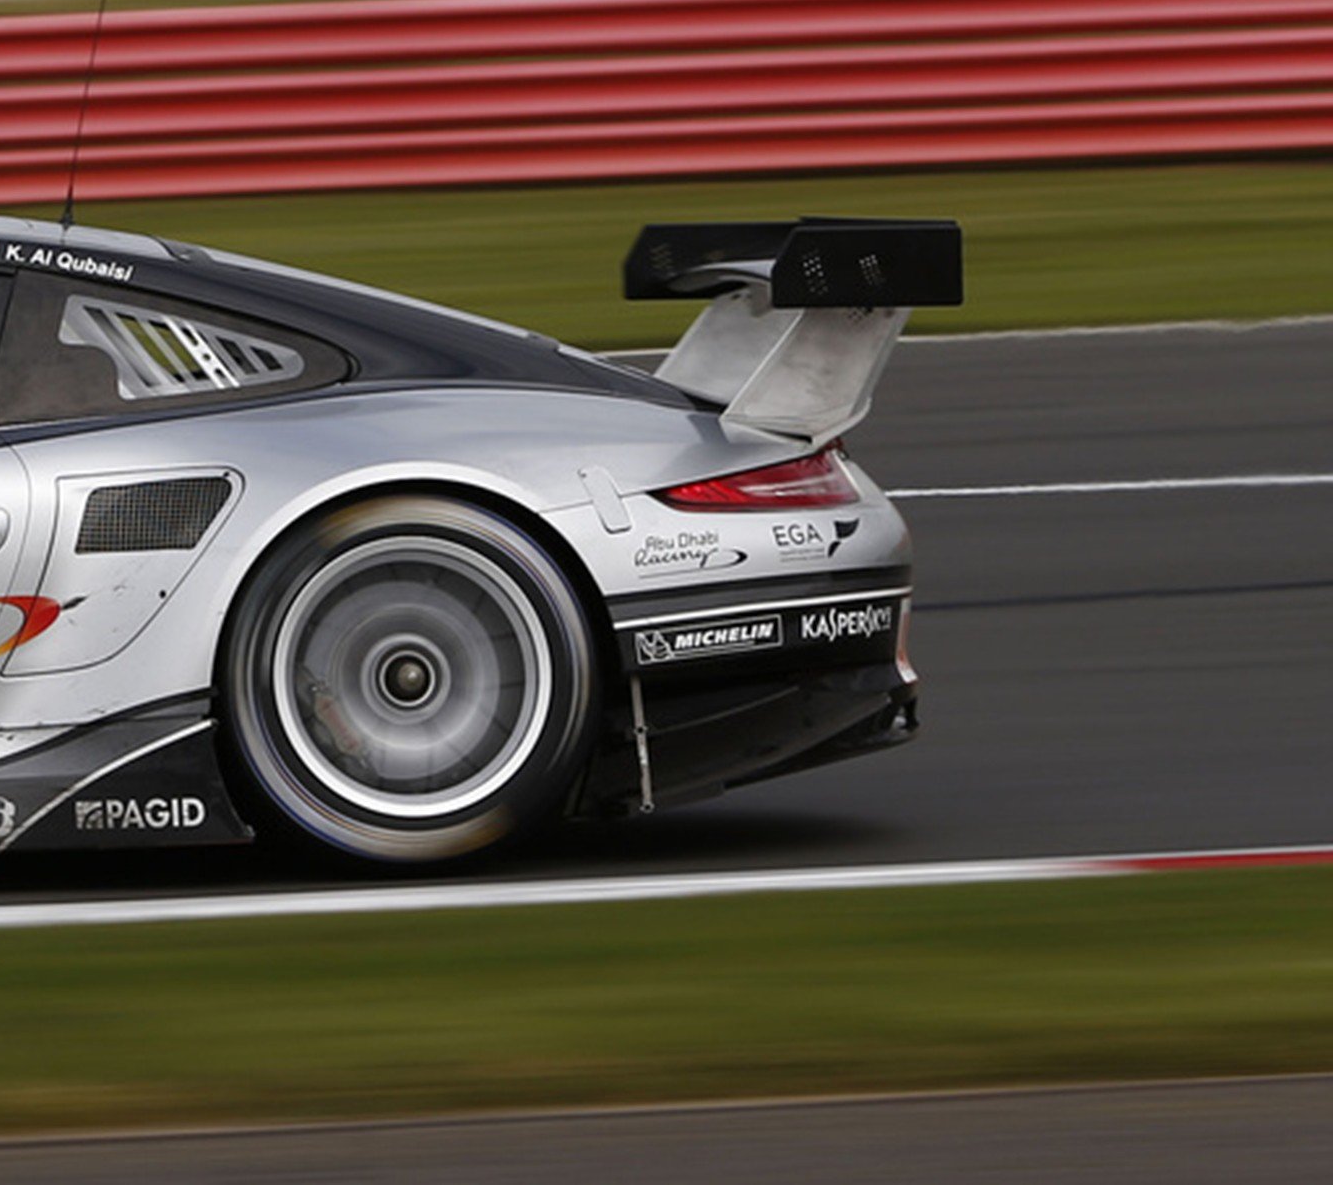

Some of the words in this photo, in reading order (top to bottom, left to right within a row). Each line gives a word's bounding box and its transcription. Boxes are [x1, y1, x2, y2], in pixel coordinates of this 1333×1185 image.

[5, 244, 26, 262] K.
[30, 248, 53, 266] Al
[56, 252, 135, 282] Qubaisi
[645, 535, 675, 551] Abu
[677, 530, 719, 548] Dhabi
[772, 523, 824, 547] EGA
[634, 547, 720, 569] Racing
[674, 621, 775, 650] MICHELIN
[106, 798, 206, 830] PAGID
